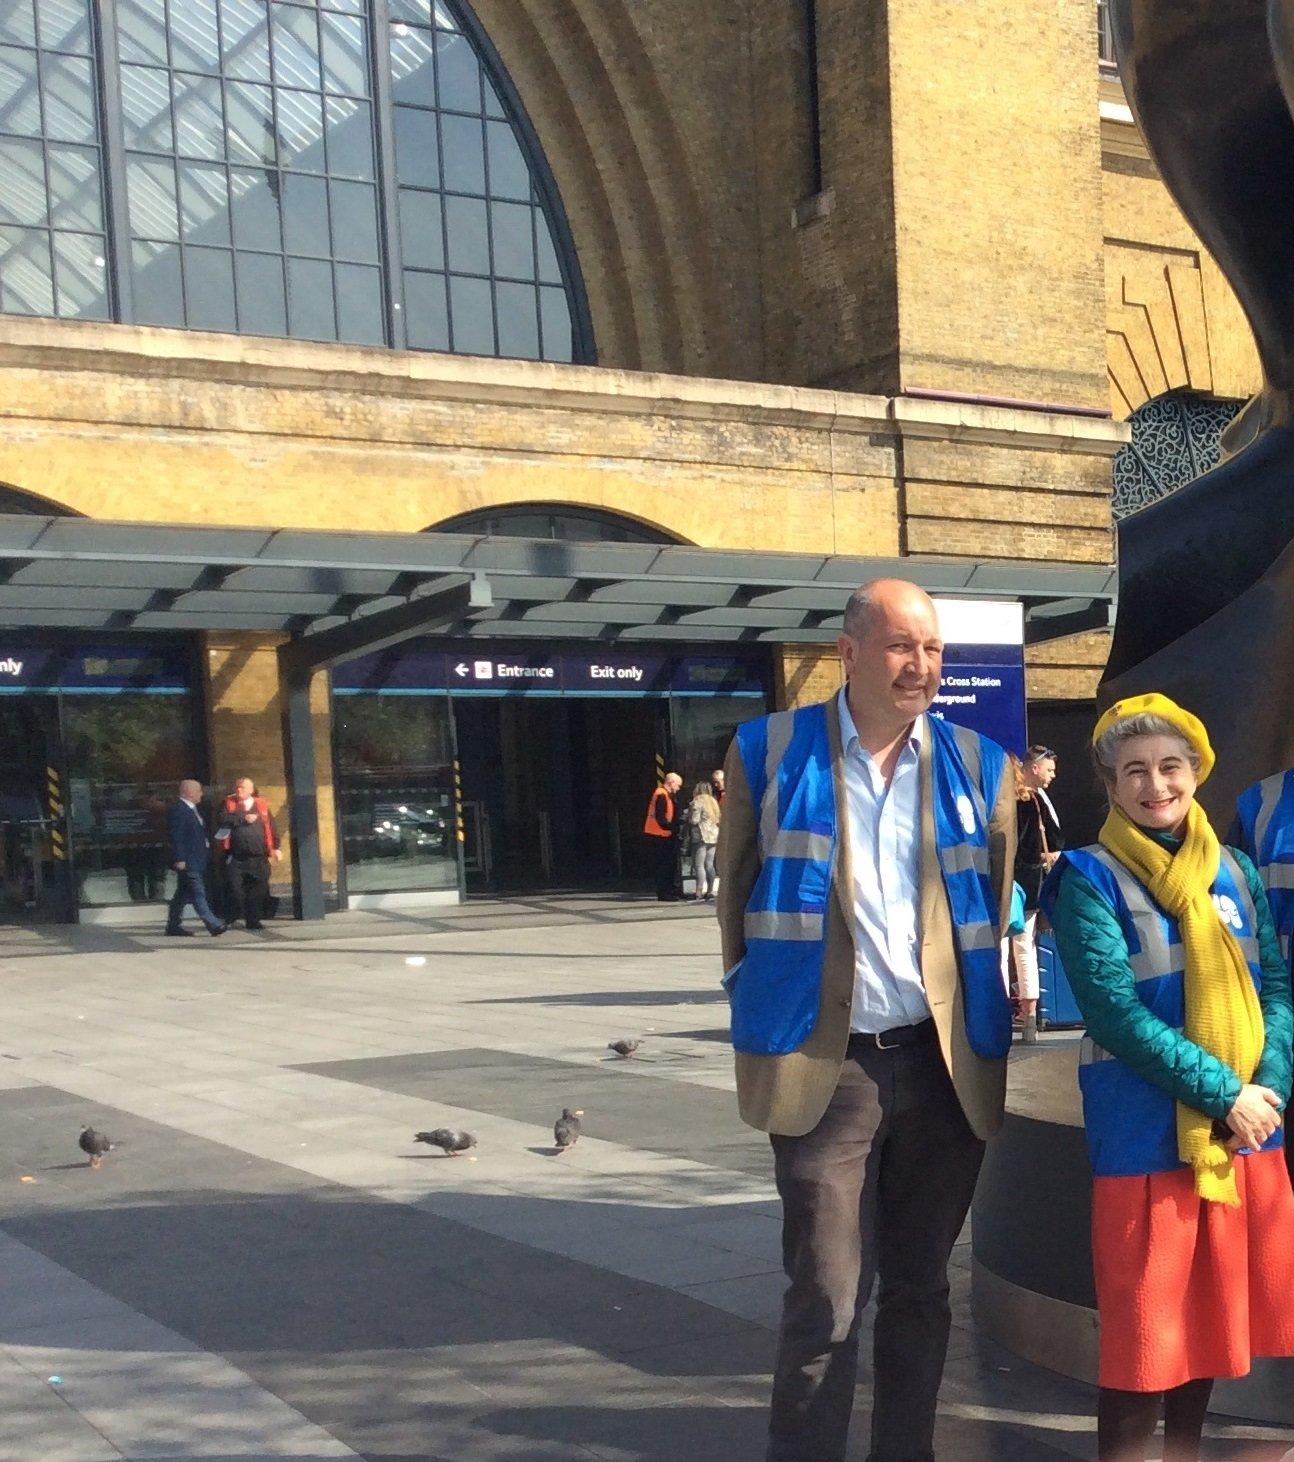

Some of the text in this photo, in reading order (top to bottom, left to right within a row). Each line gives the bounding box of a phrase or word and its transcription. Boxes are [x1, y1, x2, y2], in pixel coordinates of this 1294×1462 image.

[0, 658, 23, 675] nly
[497, 664, 554, 678] Entrance
[590, 665, 643, 681] Exit only
[946, 677, 970, 687] Cross
[971, 676, 1001, 687] Station
[933, 693, 976, 705] derground
